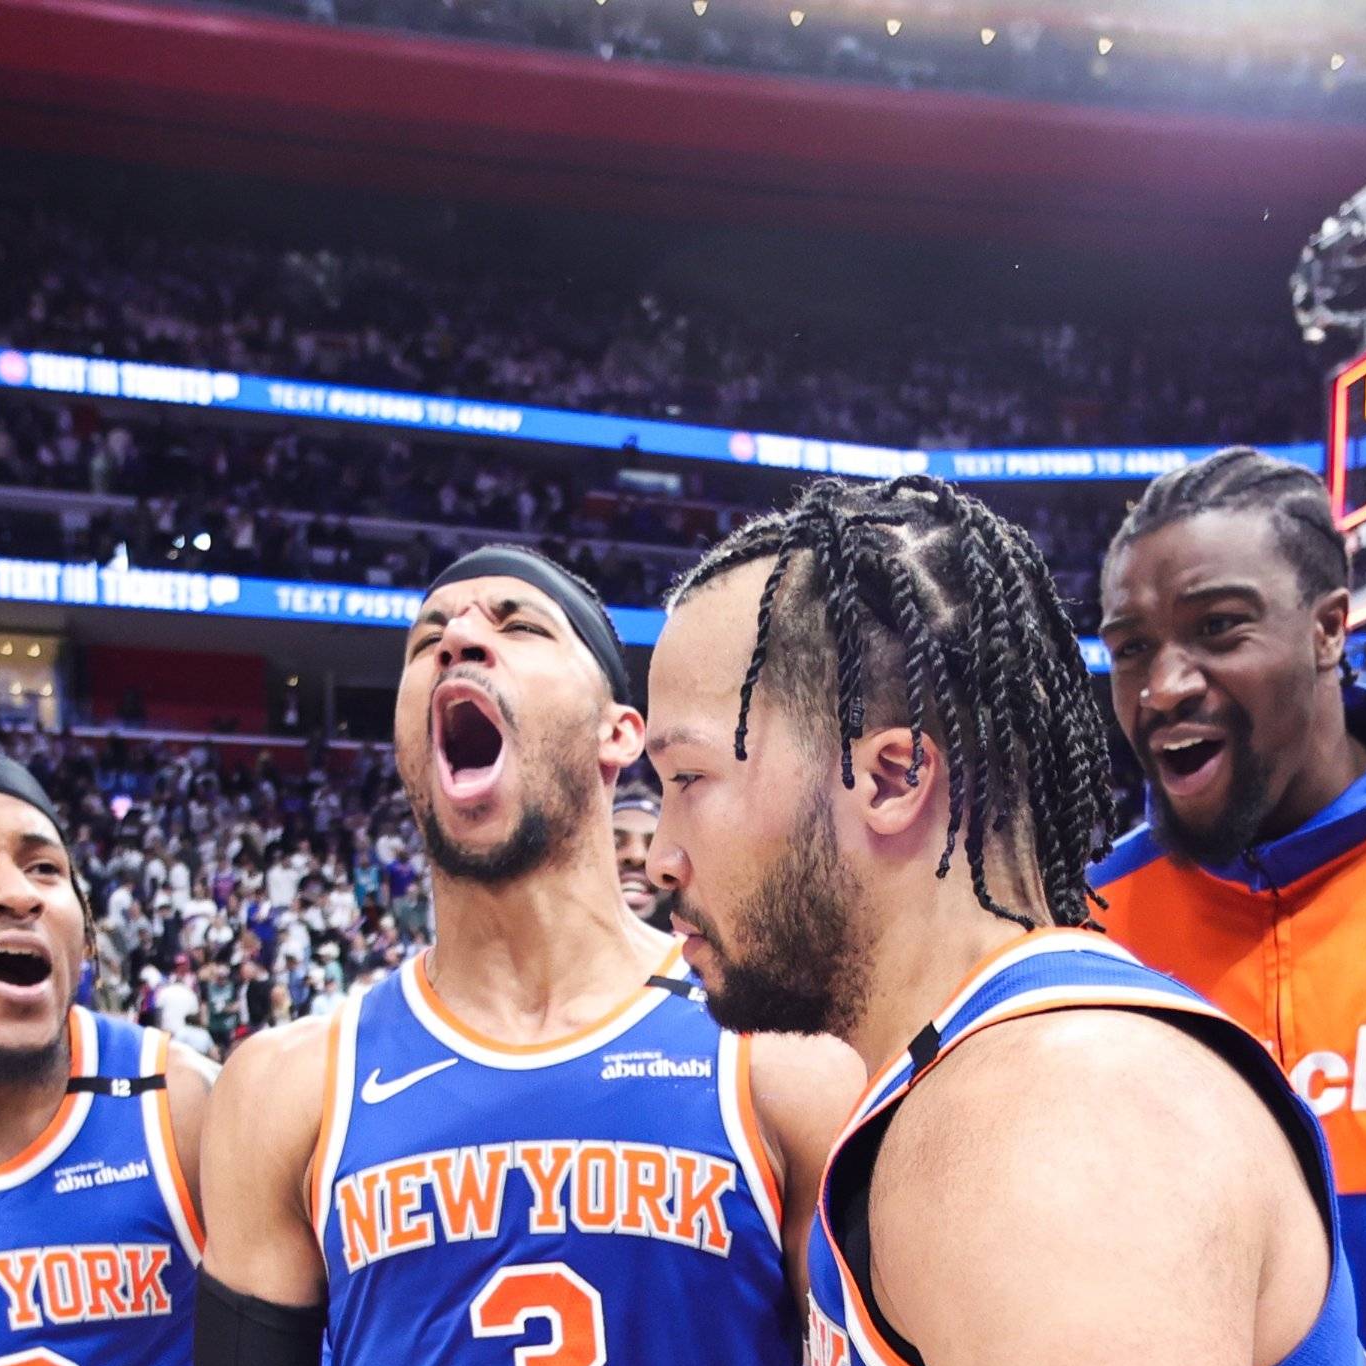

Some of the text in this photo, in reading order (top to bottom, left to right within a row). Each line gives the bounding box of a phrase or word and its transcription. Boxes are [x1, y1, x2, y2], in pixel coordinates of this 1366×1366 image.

[269, 384, 327, 410] TEXT
[328, 390, 424, 422] PISTONS
[425, 402, 456, 425] TO
[276, 586, 341, 615] TEXT
[601, 1058, 712, 1080] abu dhabi
[111, 1078, 131, 1097] 12
[56, 1160, 149, 1194] abu dhabi
[336, 1139, 737, 1274] NEW YORK
